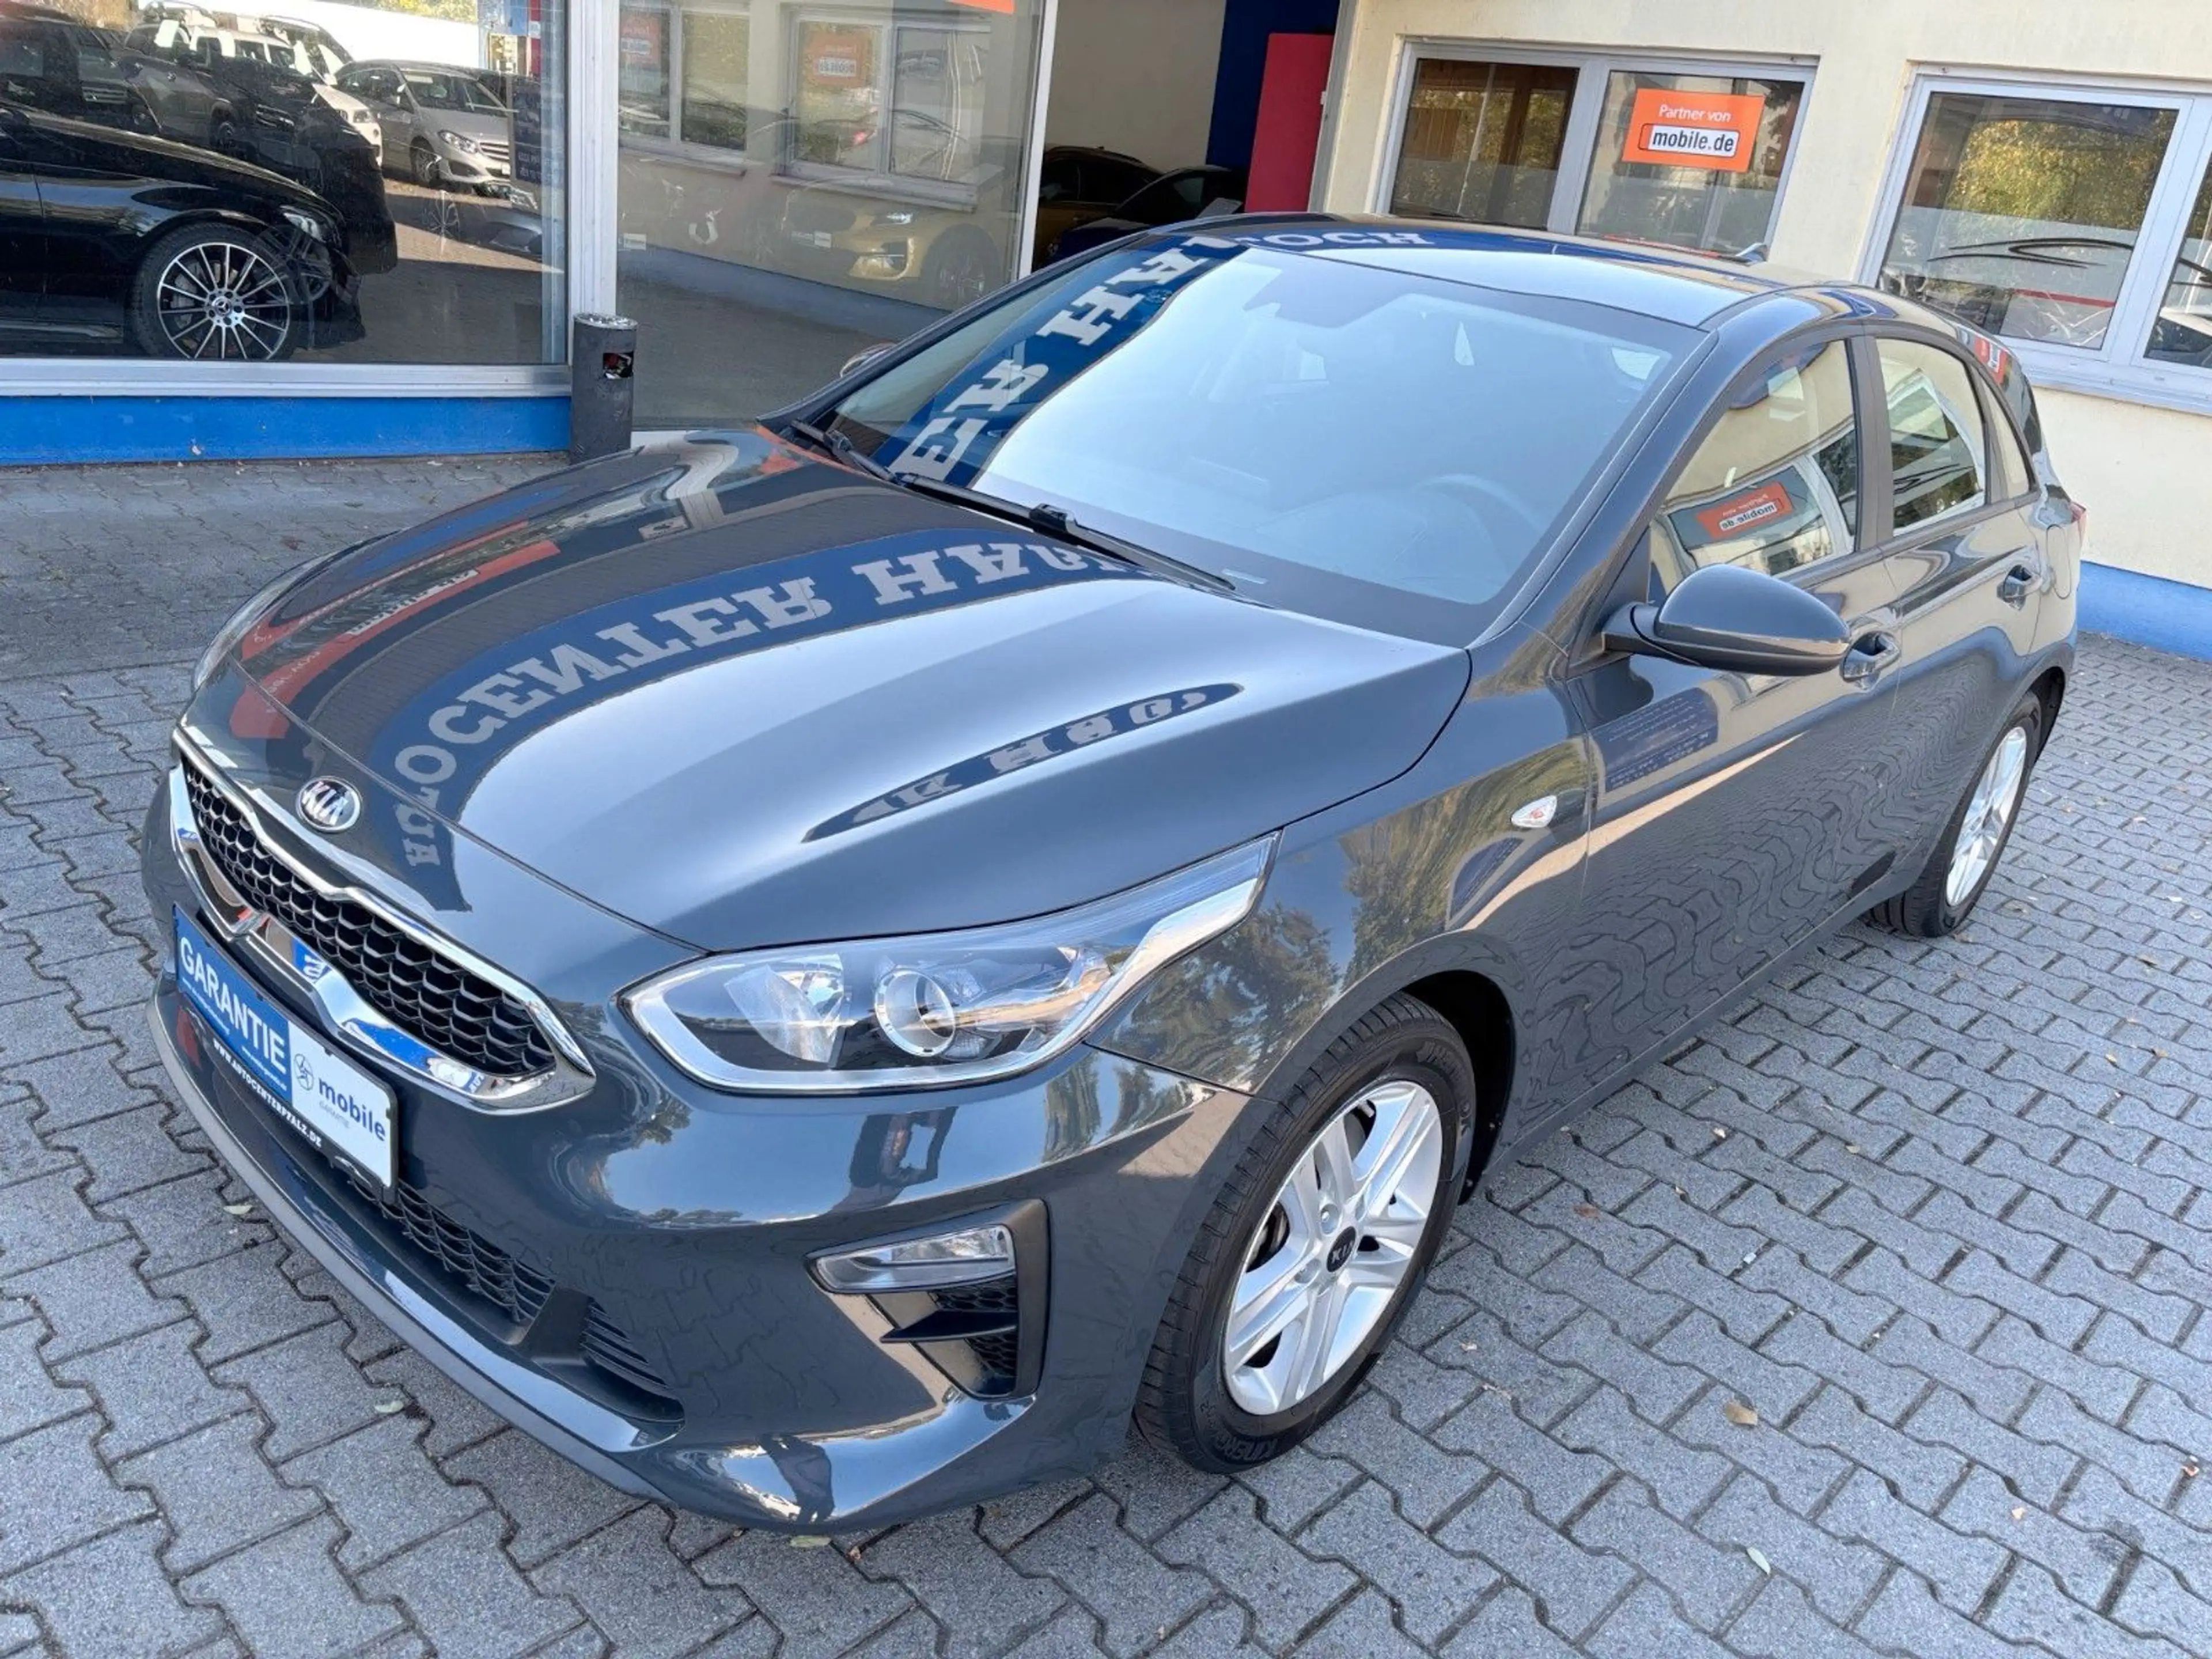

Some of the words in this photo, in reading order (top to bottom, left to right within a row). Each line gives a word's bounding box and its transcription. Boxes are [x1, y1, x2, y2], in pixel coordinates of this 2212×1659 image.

[1658, 104, 1706, 120] Partner
[1707, 111, 1731, 123] von
[1652, 130, 1734, 152] mobile.de
[301, 781, 349, 825] KIA
[180, 937, 287, 1075] GARANTIE
[319, 1077, 386, 1142] mobile
